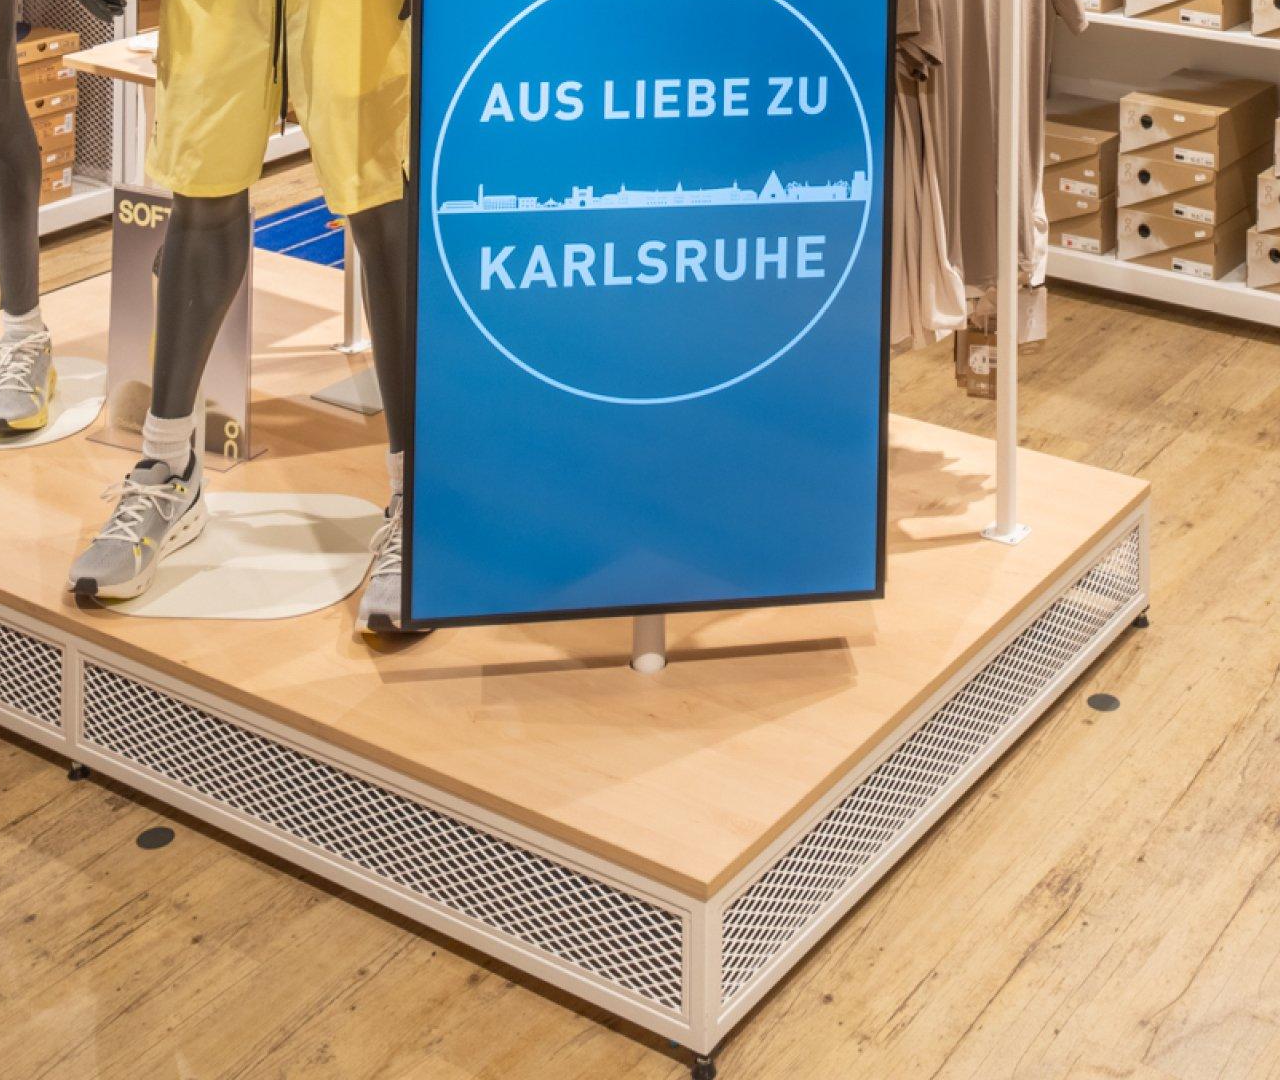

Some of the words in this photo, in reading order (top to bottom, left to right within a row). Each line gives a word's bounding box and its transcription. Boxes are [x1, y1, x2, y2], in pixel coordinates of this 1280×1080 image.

[480, 80, 585, 123] AUS
[603, 78, 750, 120] LIEBE
[767, 76, 828, 116] ZU
[480, 235, 826, 291] KARLSRUHE
